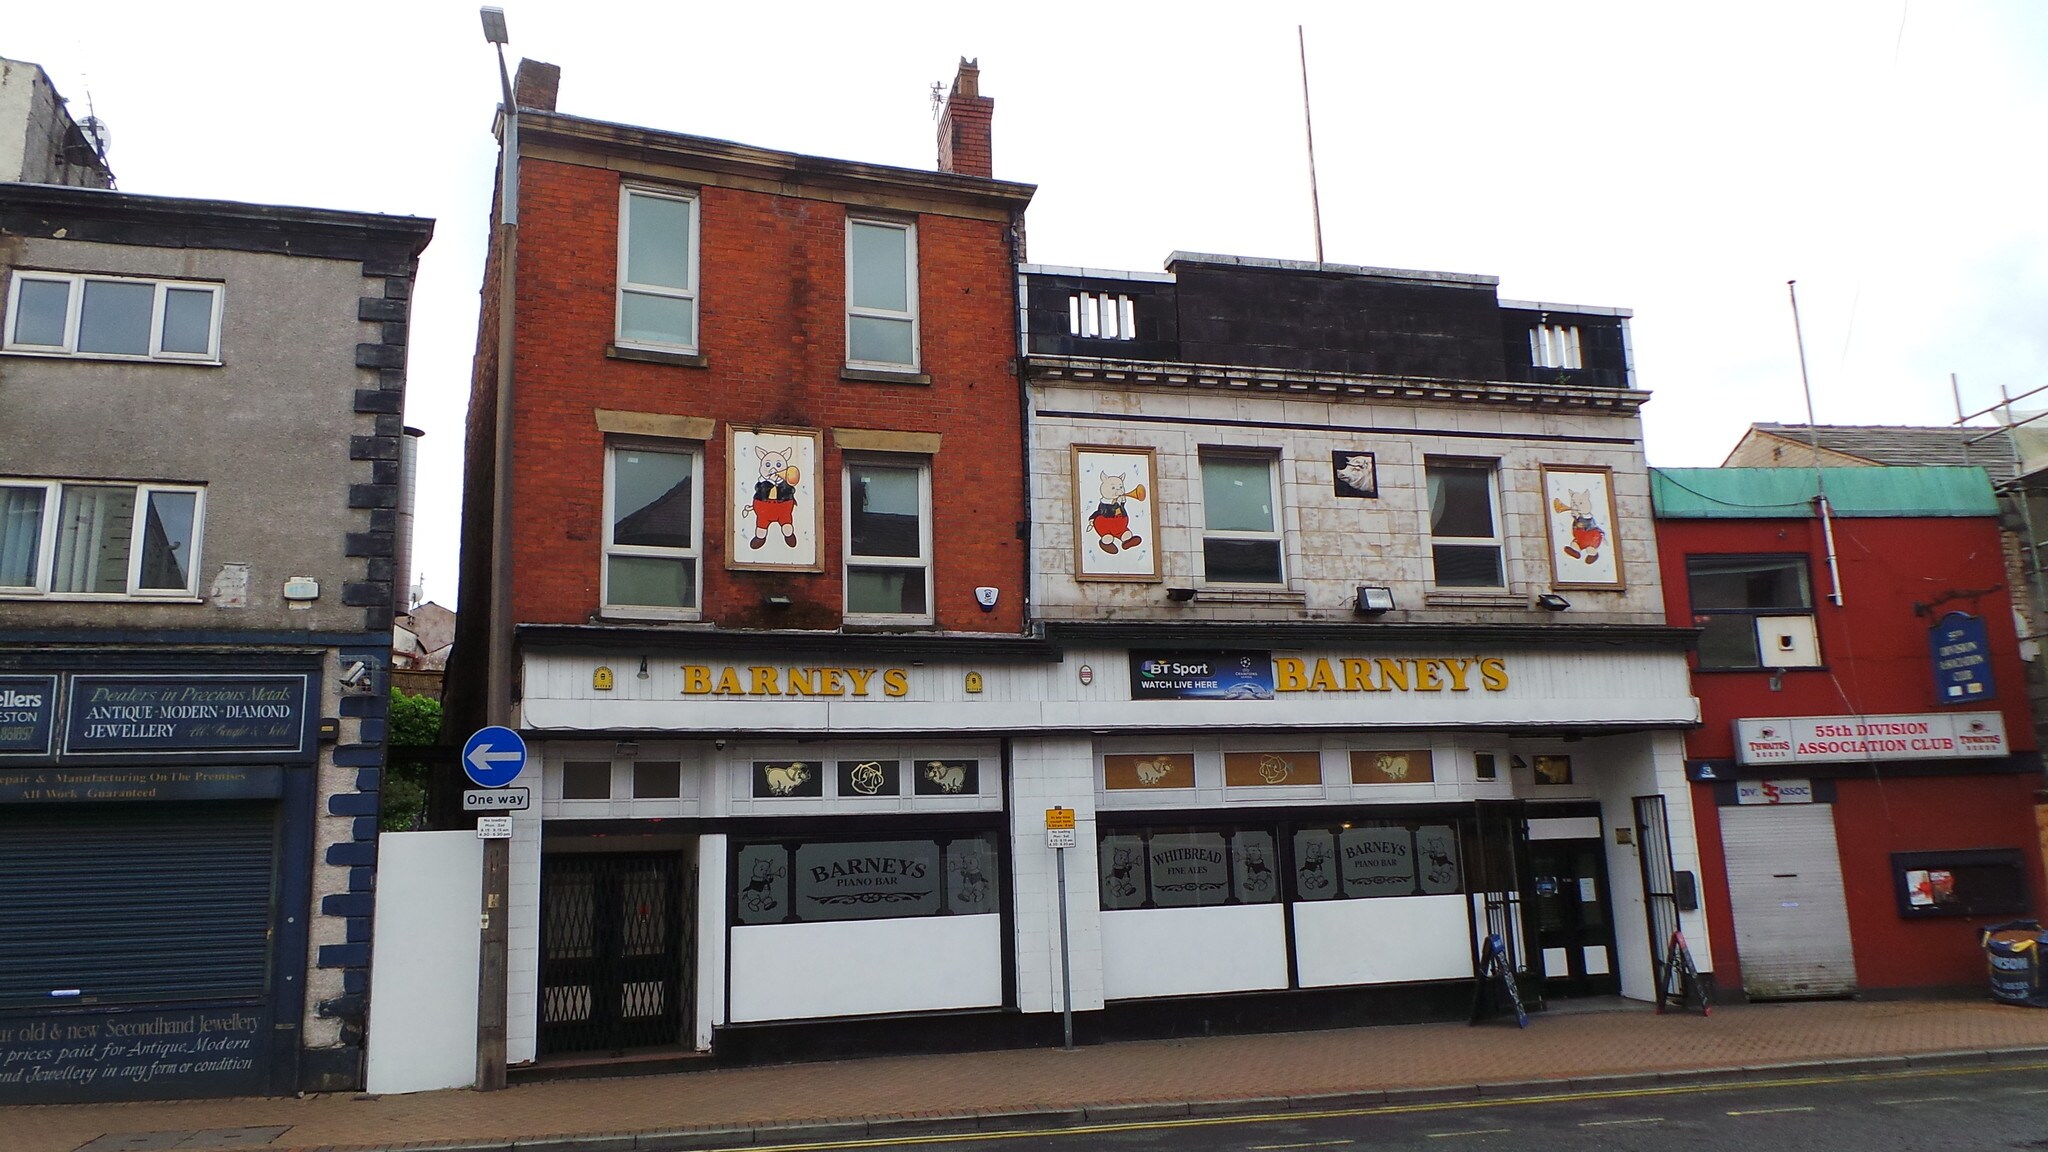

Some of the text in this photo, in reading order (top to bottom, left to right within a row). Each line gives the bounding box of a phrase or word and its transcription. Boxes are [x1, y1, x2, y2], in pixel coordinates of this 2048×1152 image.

[1150, 662, 1208, 676] BT Sport
[1273, 655, 1509, 692] BARNEY'S
[1141, 680, 1218, 689] WATCH LIVE HERE
[0, 690, 42, 707] llers
[90, 686, 291, 702] Dealers in Precious Metals
[86, 704, 290, 720] ANTIQUE MODERN DIAMOND
[84, 724, 177, 738] JEWELLERY
[1815, 722, 1929, 738] 55th DIVISION
[1797, 738, 1953, 754] ASSOCIATION CLUB
[35, 775, 45, 784] &
[56, 772, 146, 783] Manufacturing
[150, 772, 167, 781] On
[195, 772, 246, 781] Premises
[22, 787, 156, 799] All Work Guaranteed
[467, 794, 524, 805] One way
[1153, 847, 1222, 866] WHITBREAD
[1345, 841, 1406, 859] BARNEYS
[810, 857, 927, 883] BARNEYS
[1168, 866, 1208, 875] FINE ALES
[1354, 859, 1398, 868] PIANO BAR
[837, 877, 898, 887] PIANO BAR
[19, 1023, 46, 1041] old
[50, 1023, 62, 1040] &
[67, 1024, 99, 1039] new
[105, 1015, 194, 1037] Secondhand
[199, 1013, 261, 1034] Jewellery
[3, 1047, 53, 1067] prices
[54, 1044, 97, 1065] paid
[94, 1042, 126, 1062] for
[187, 1037, 251, 1053] Modern
[26, 1065, 98, 1085] Jewellery
[101, 1063, 118, 1078] in
[120, 1064, 148, 1082] any
[143, 1060, 178, 1082] form
[178, 1062, 193, 1073] or
[194, 1057, 253, 1072] condition
